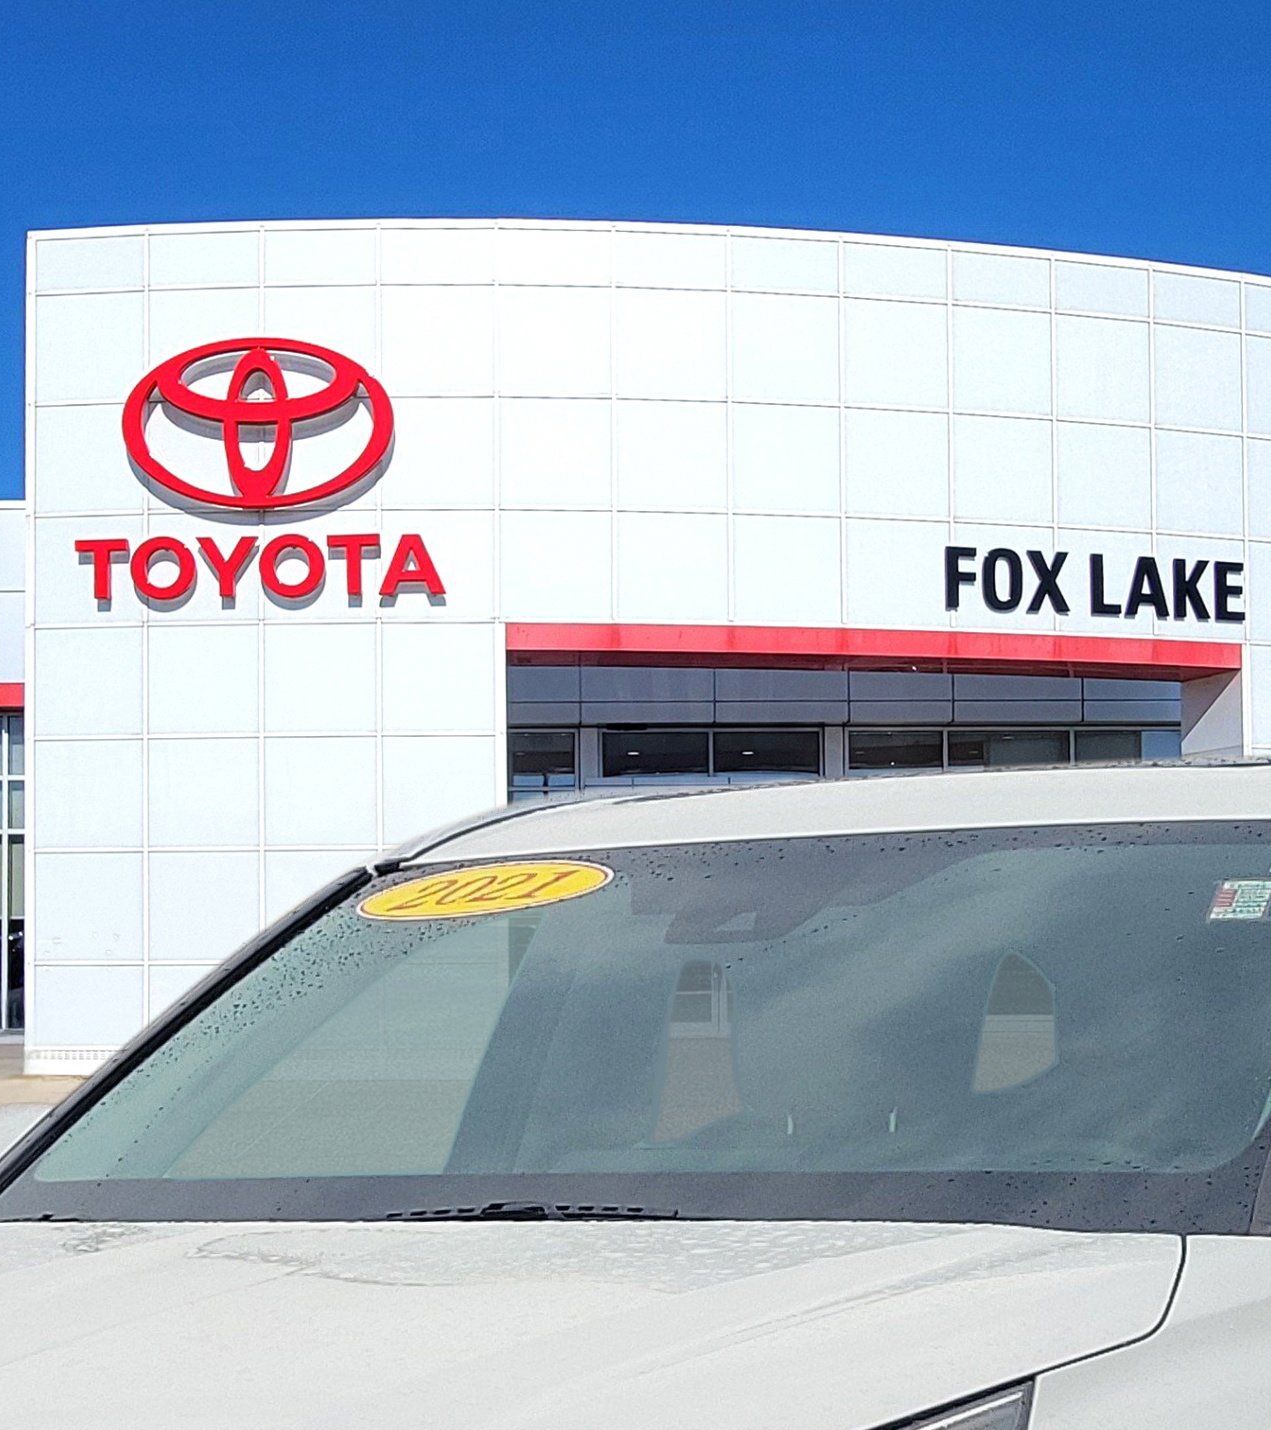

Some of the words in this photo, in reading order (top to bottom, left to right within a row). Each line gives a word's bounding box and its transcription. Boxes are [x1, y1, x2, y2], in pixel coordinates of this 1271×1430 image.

[75, 534, 446, 602] TOYOTA
[945, 546, 1070, 614] FOX
[1090, 553, 1246, 622] LAKE
[385, 869, 580, 912] 2021
